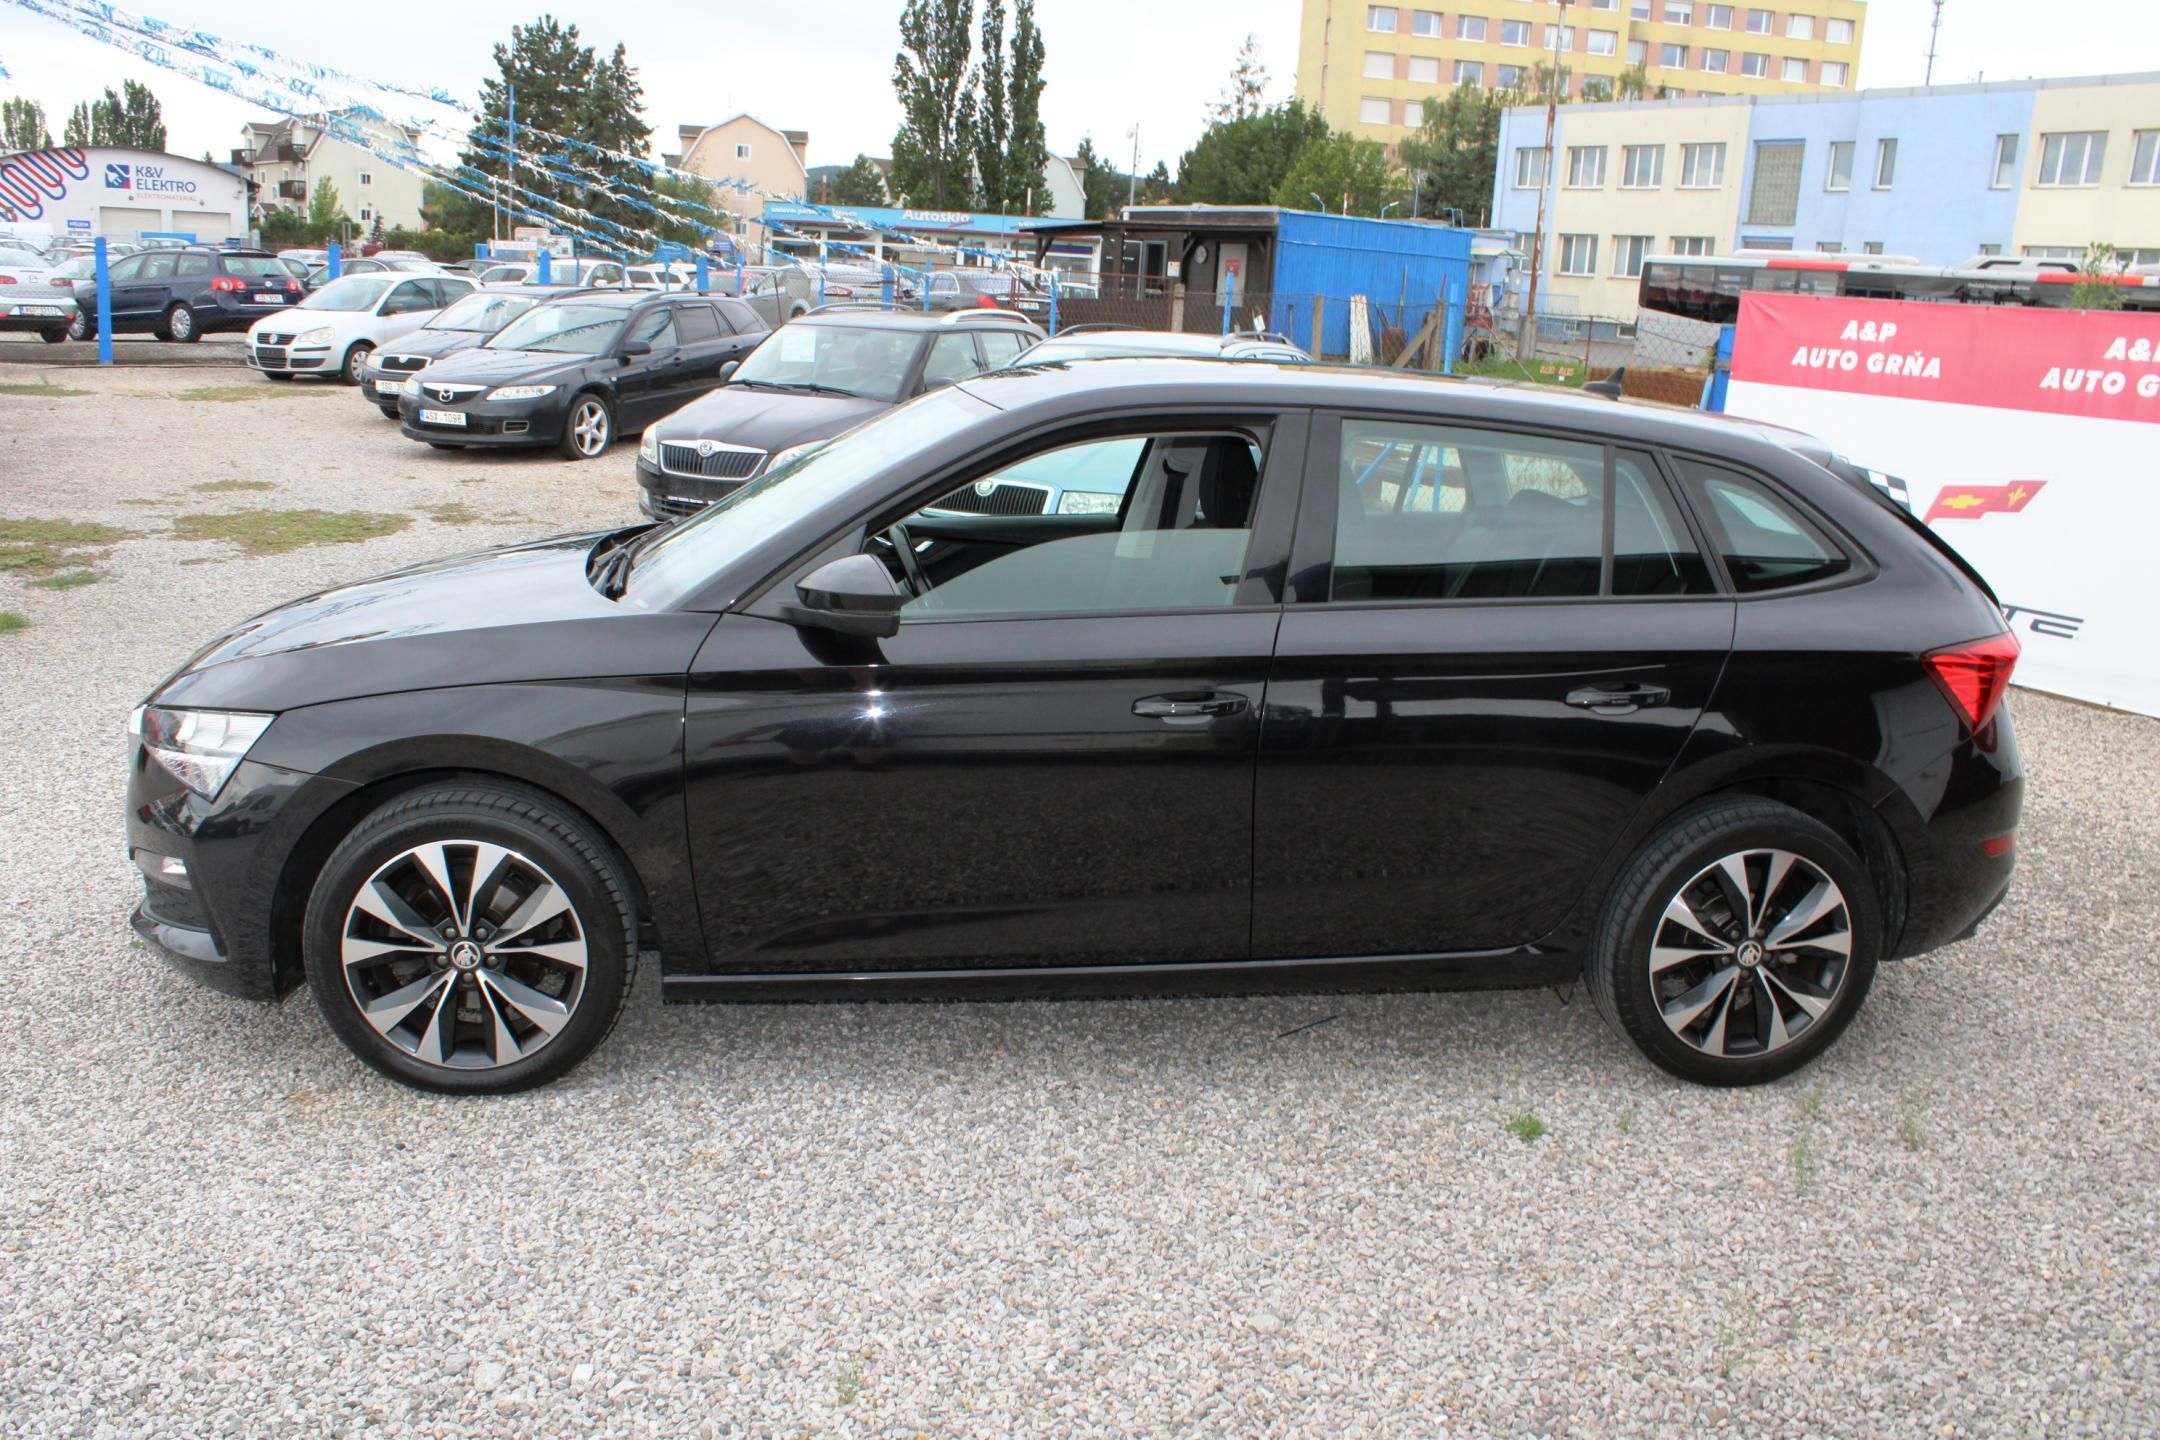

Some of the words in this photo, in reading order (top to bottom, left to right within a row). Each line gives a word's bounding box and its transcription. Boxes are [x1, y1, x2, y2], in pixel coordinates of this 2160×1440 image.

[136, 166, 163, 178] K&V
[136, 179, 196, 193] ELEKTRO
[902, 209, 969, 222] Autosklo
[1840, 320, 1897, 342] A&P
[1791, 346, 1858, 370] AUTO
[1866, 350, 1941, 378] GRŇA
[2038, 367, 2126, 395] AUTO
